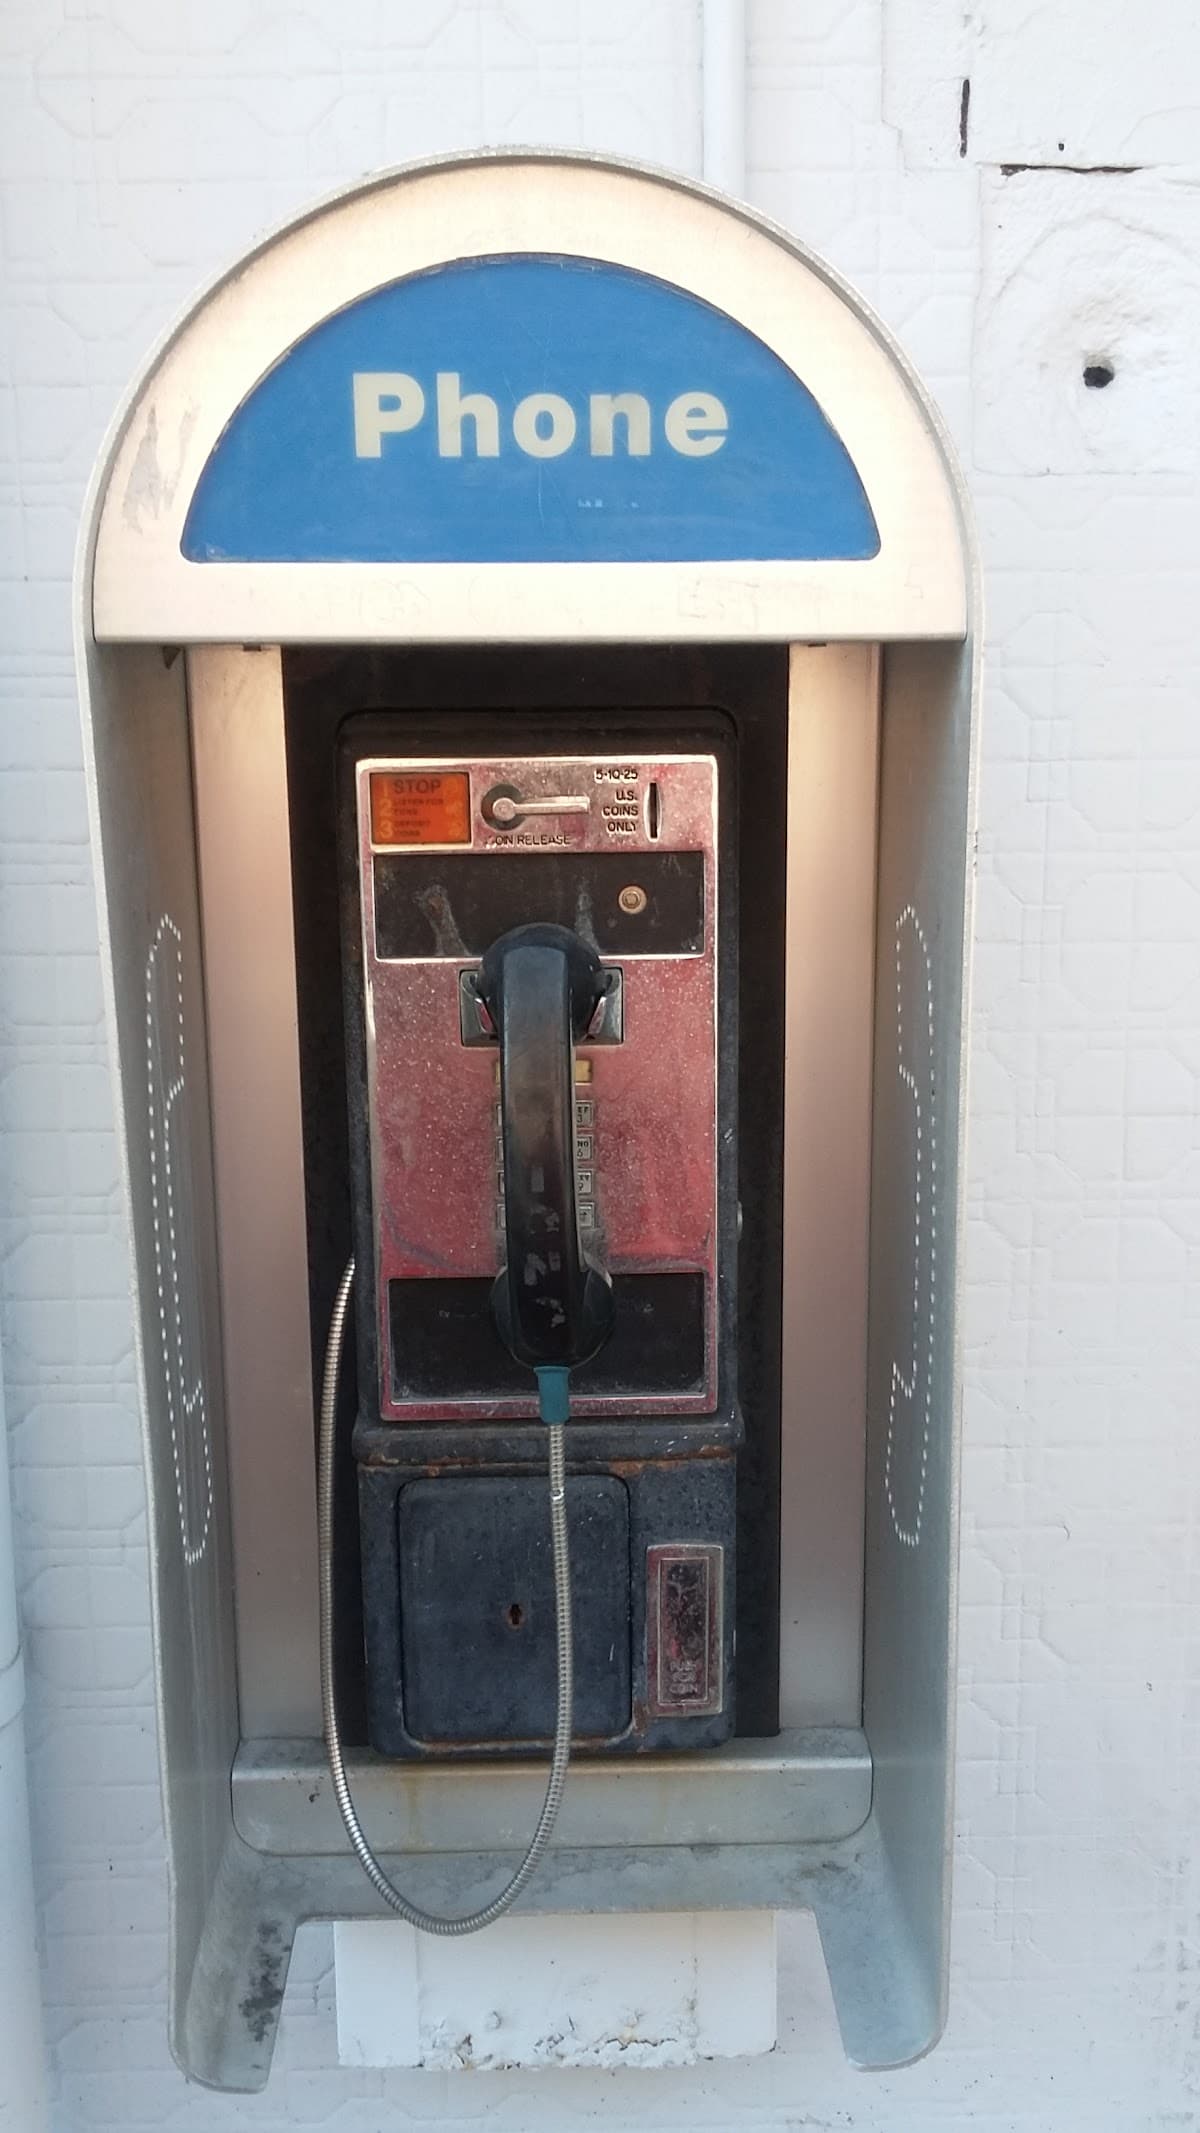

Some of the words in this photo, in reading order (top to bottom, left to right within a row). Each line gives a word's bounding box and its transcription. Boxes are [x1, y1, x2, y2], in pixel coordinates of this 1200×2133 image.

[352, 371, 730, 459] Phone
[393, 779, 441, 794] STOP
[615, 789, 638, 802] U.S.
[602, 805, 639, 818] COINS
[379, 820, 393, 839] 3
[607, 821, 636, 833] ONLY
[517, 833, 571, 846] RELEASE
